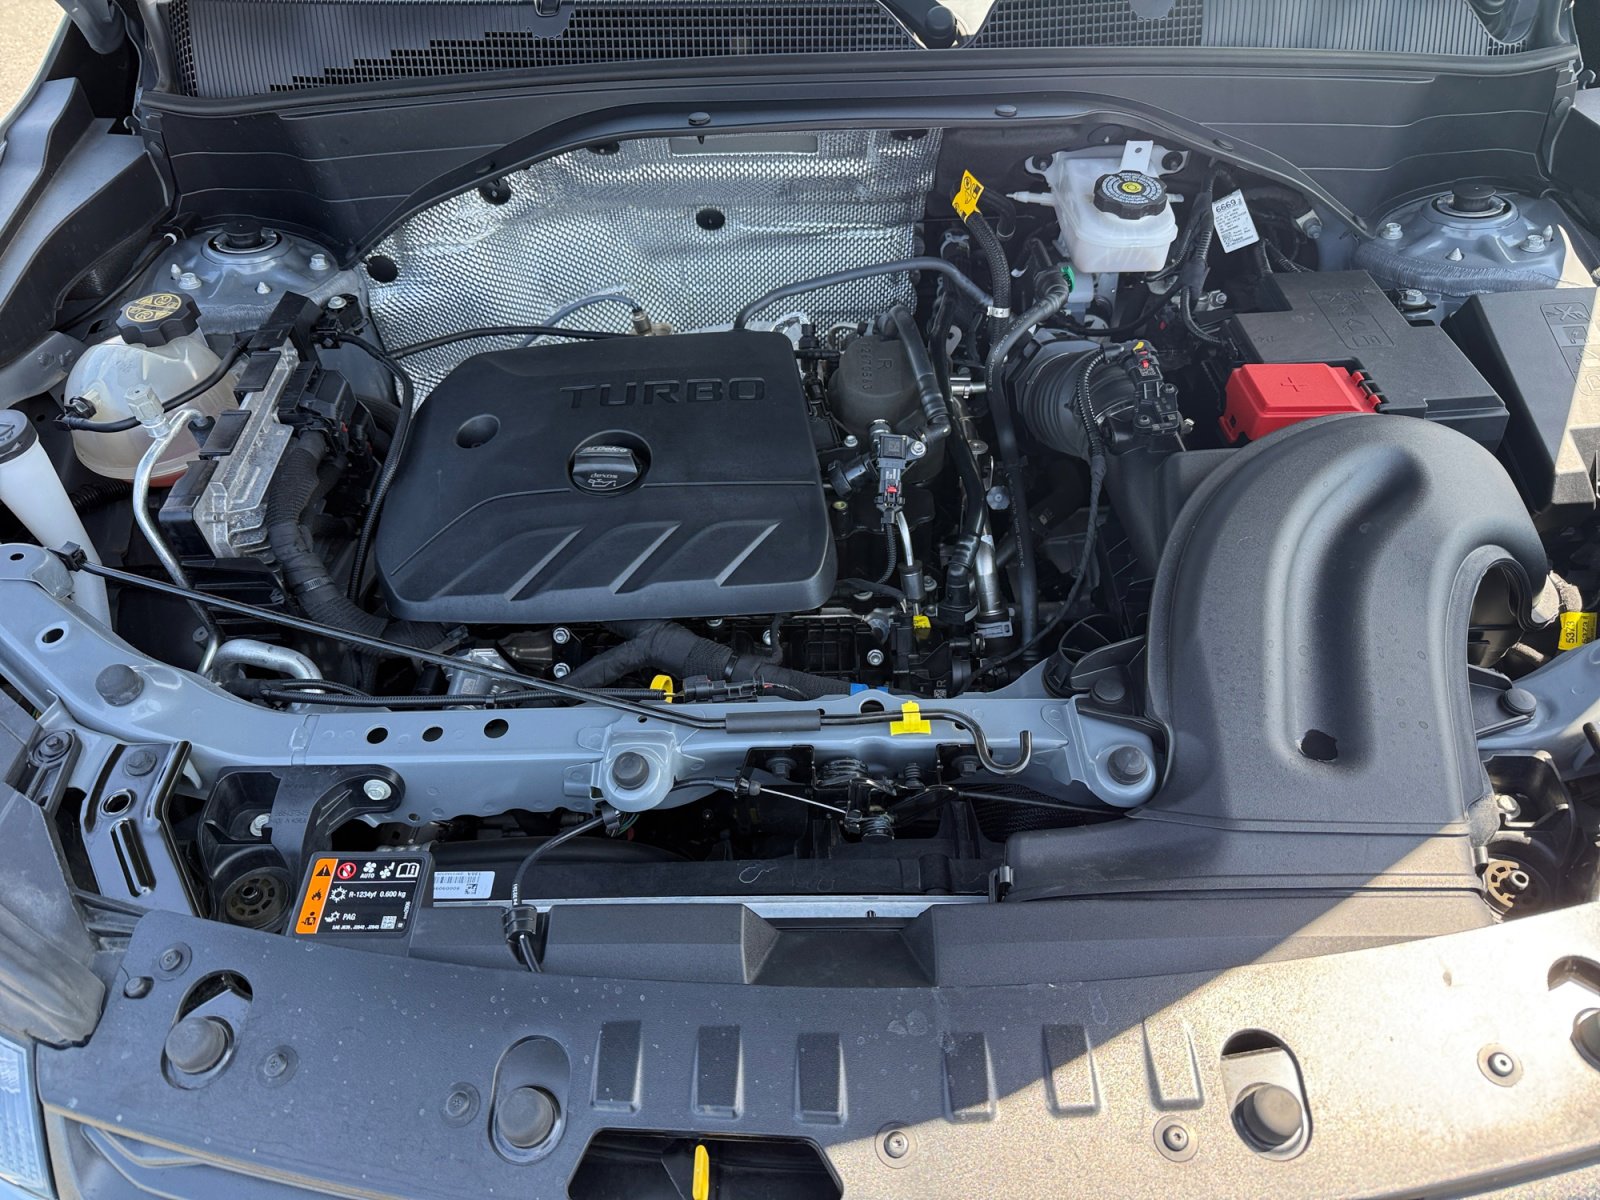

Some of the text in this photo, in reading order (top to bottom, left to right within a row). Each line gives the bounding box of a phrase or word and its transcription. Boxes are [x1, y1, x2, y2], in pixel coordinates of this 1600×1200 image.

[1215, 199, 1237, 213] 6669
[560, 376, 766, 409] TURBO
[1565, 621, 1575, 643] 5373
[348, 890, 407, 899] R-1234yf 0.600 kg
[342, 913, 357, 921] PAG
